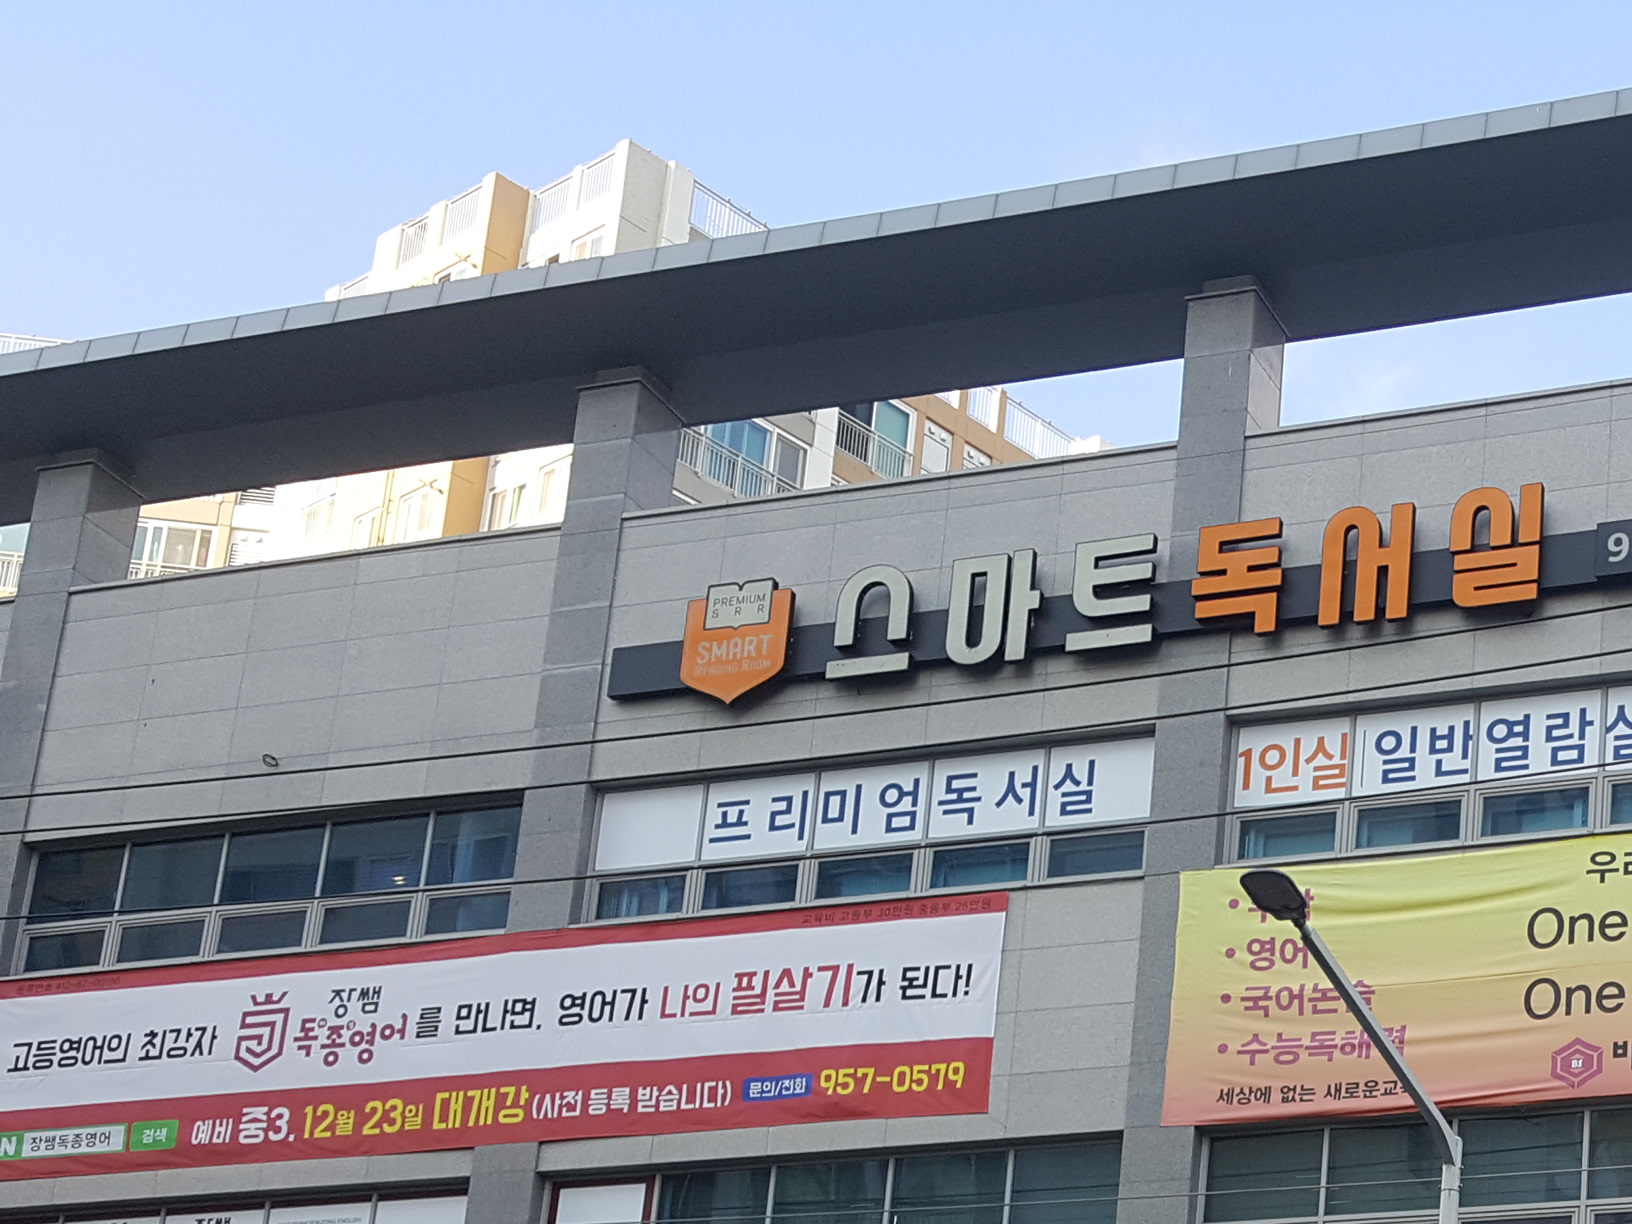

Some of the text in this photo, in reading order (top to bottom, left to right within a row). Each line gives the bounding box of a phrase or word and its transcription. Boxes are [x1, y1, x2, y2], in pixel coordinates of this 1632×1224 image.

[713, 593, 767, 608] PREMIUM
[696, 634, 773, 664] SMART
[1237, 731, 1348, 796] 1인실
[707, 759, 1098, 845] 프리미엄독서실
[1526, 906, 1628, 950] One
[1246, 936, 1309, 972] 영어
[327, 985, 382, 1018] 장쌤
[415, 962, 974, 1039] 를 만나면, 영어가 나의 된다!
[1523, 976, 1626, 1021] One
[6, 1023, 218, 1074] 고등영어의 최강자
[748, 1061, 966, 1098] 문의/전화 957-0579
[1215, 1082, 1317, 1106] 세상에 없는
[190, 1078, 732, 1145] 예비 12월 23일 대개강 등록 받습니다)
[28, 1126, 168, 1153] 장쌤독종영어 검색
